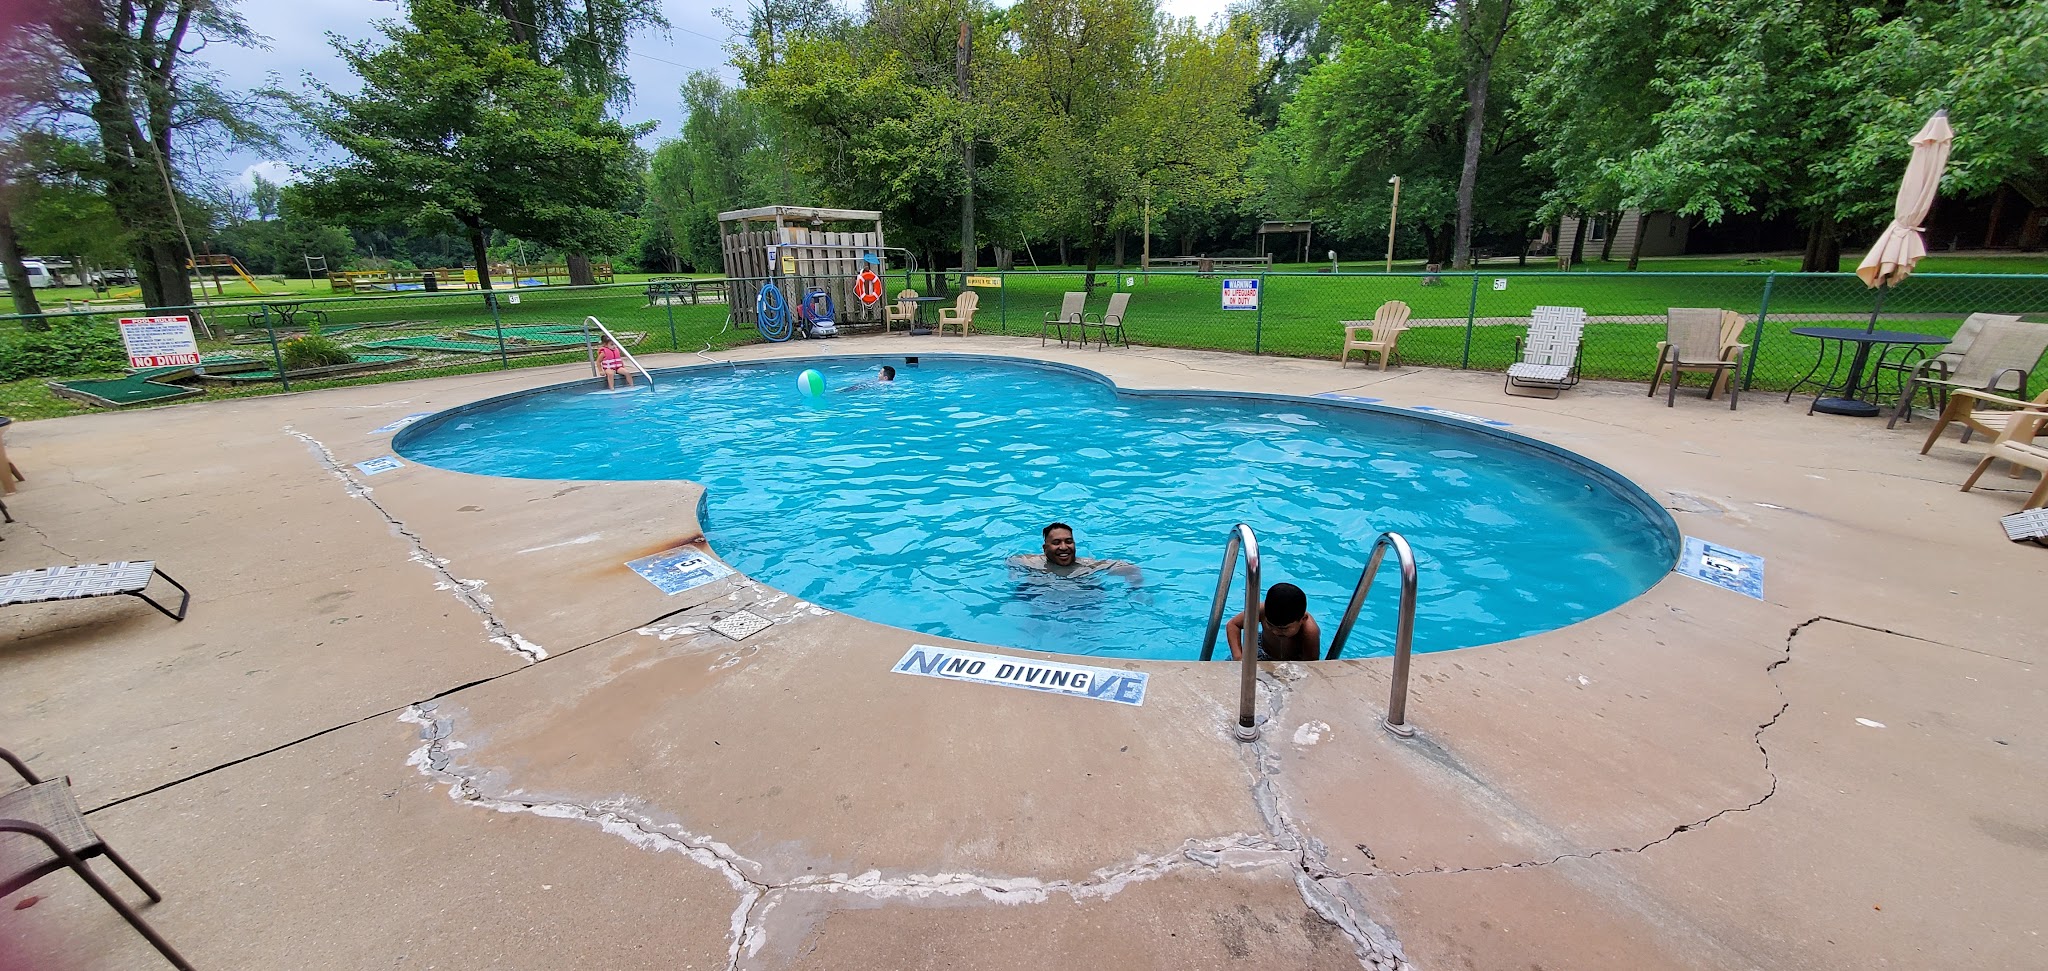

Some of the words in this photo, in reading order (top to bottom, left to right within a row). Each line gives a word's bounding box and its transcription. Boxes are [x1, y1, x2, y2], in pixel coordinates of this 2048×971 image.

[1229, 280, 1252, 288] WARNING
[134, 357, 153, 367] NO
[156, 355, 197, 366] DIVING
[946, 657, 986, 676] NO
[995, 664, 1088, 688] DIVING
